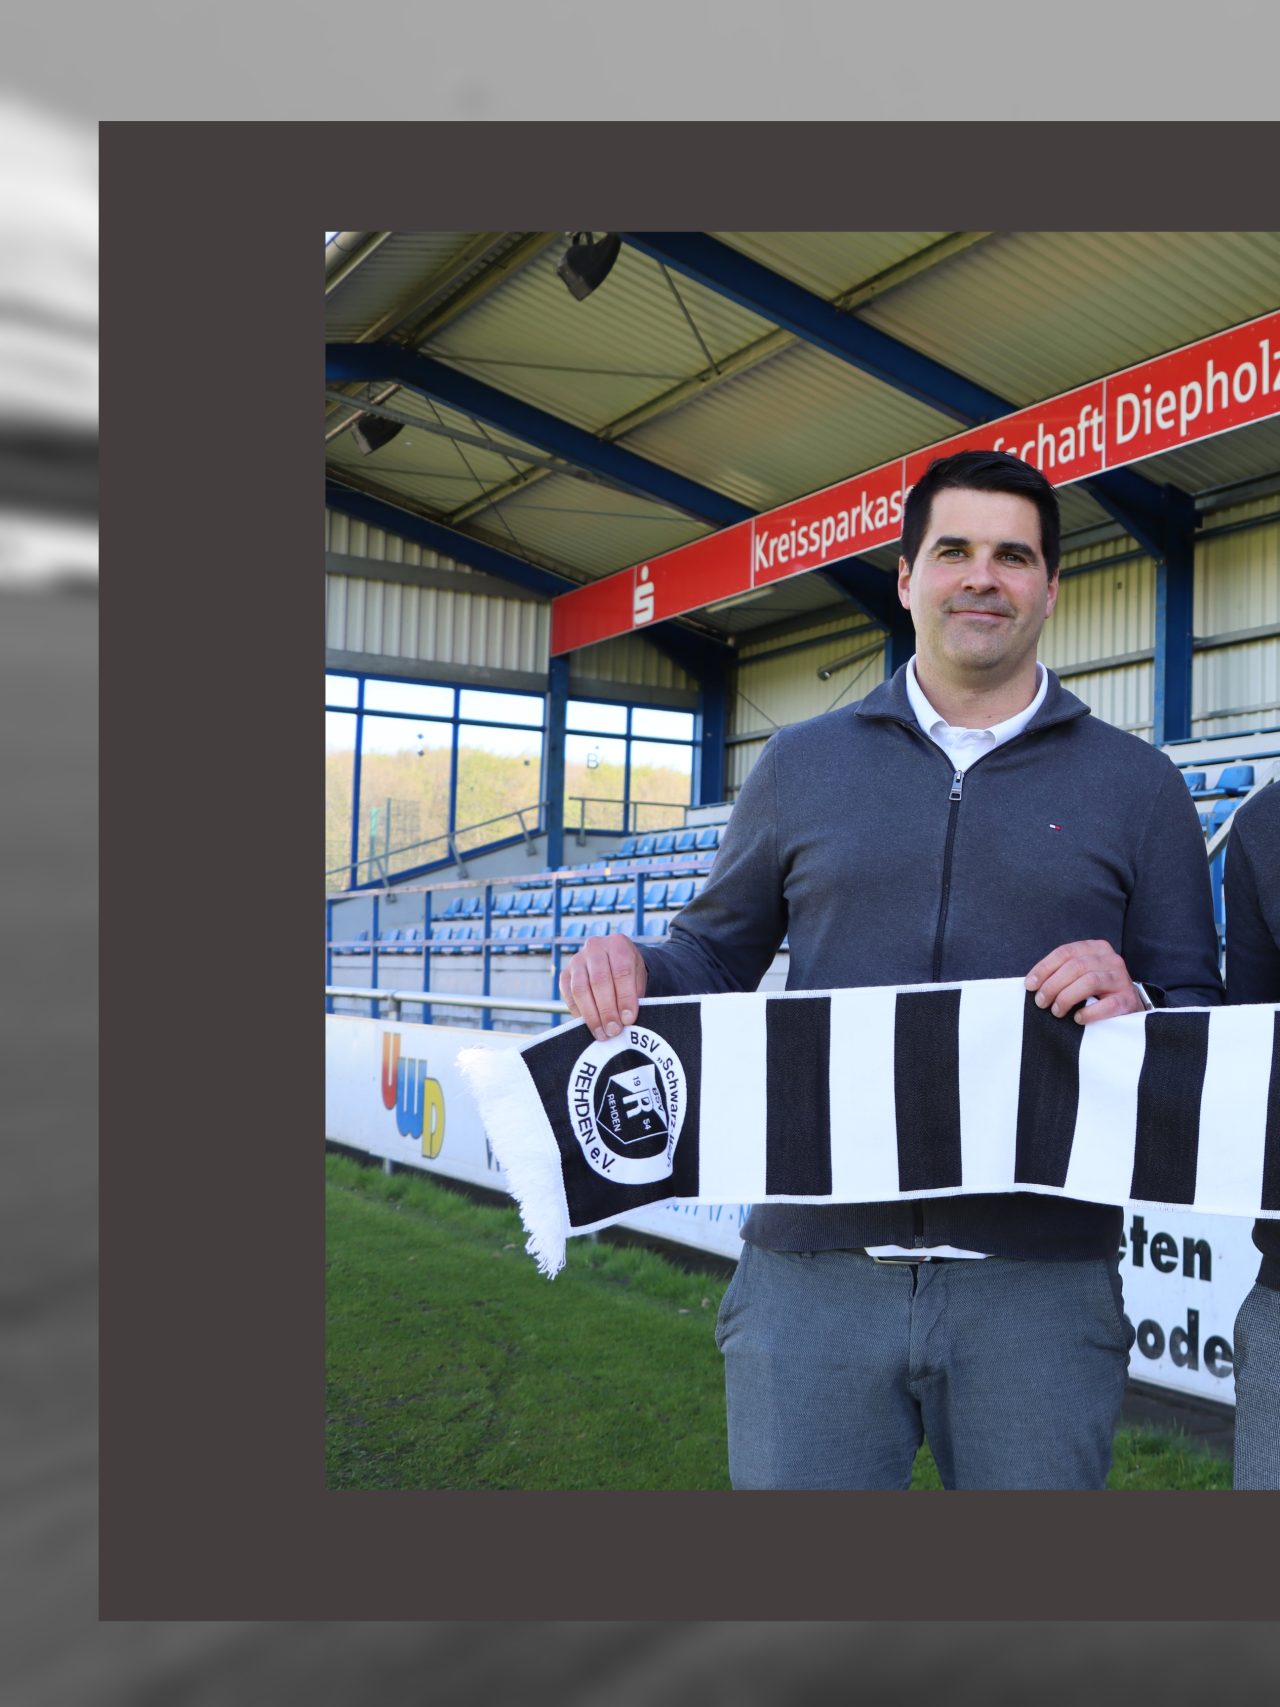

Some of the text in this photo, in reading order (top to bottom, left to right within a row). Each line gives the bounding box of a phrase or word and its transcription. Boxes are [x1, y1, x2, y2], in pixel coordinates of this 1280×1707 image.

[993, 404, 1104, 471] chaft
[630, 1031, 660, 1054] BSV
[574, 1061, 616, 1173] REHDEN e.V.
[606, 1093, 622, 1132] REHDEN
[1119, 1214, 1212, 1282] ten
[1124, 1307, 1234, 1379] ode
